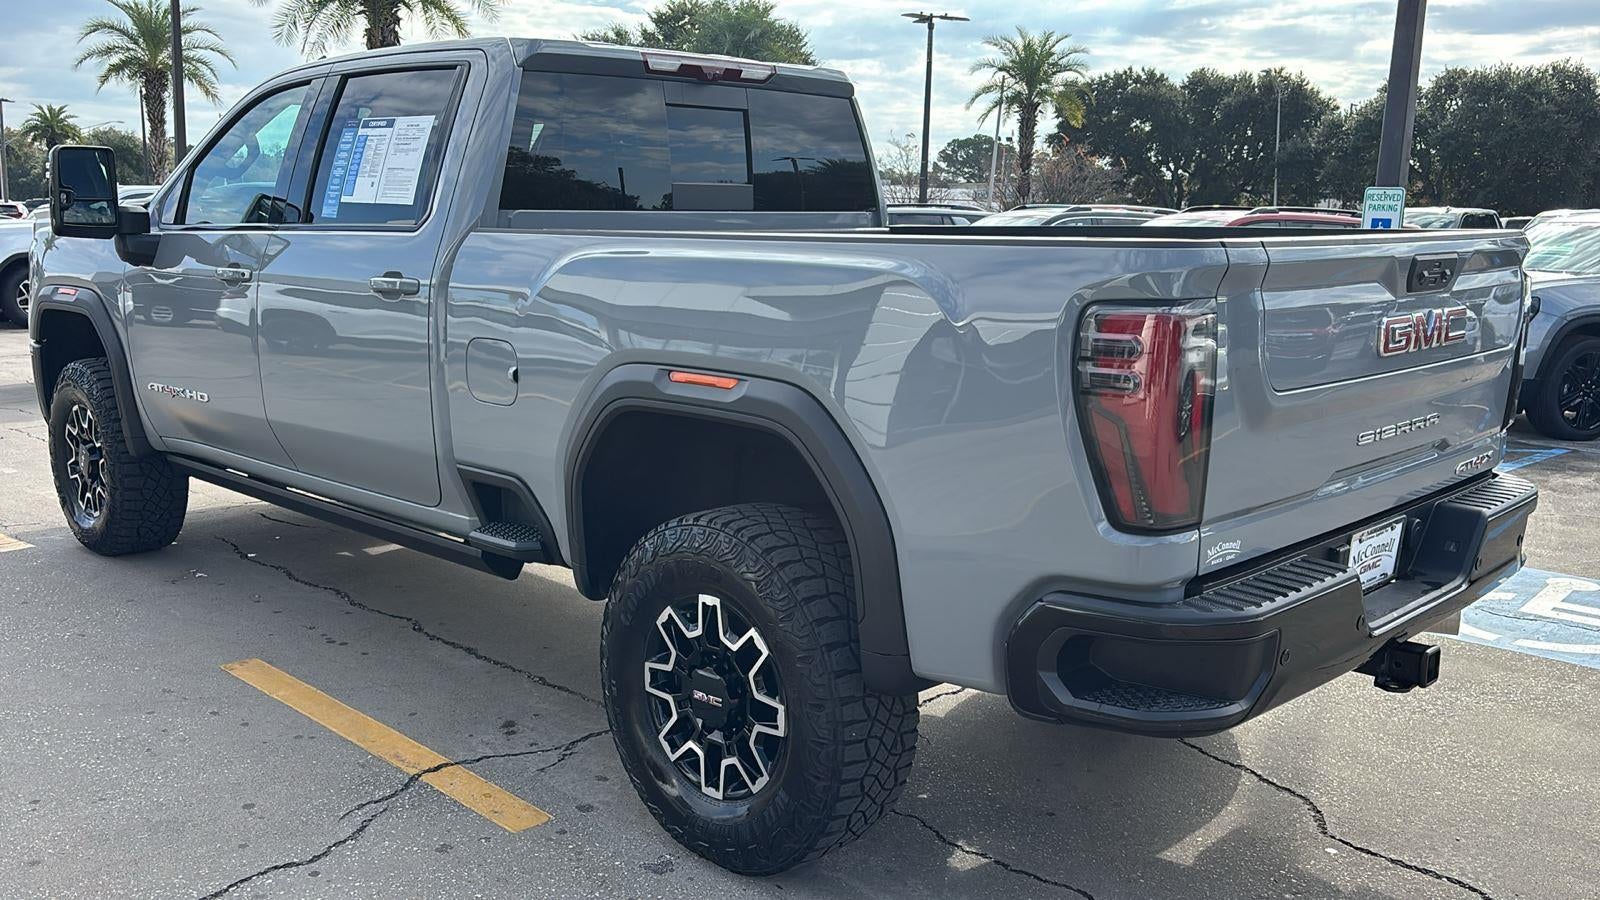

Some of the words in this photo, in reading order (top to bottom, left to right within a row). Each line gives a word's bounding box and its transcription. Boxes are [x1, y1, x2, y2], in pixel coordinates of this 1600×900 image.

[1367, 193, 1402, 202] RESERVED
[1368, 203, 1398, 212] PARKING
[1379, 305, 1468, 357] GMC
[1356, 412, 1441, 446] SIERRA
[1455, 450, 1494, 475] AT4X
[1207, 540, 1241, 558] McConnell
[1353, 537, 1396, 565] McConnell
[1359, 558, 1382, 575] GMC
[692, 689, 723, 708] GMC
